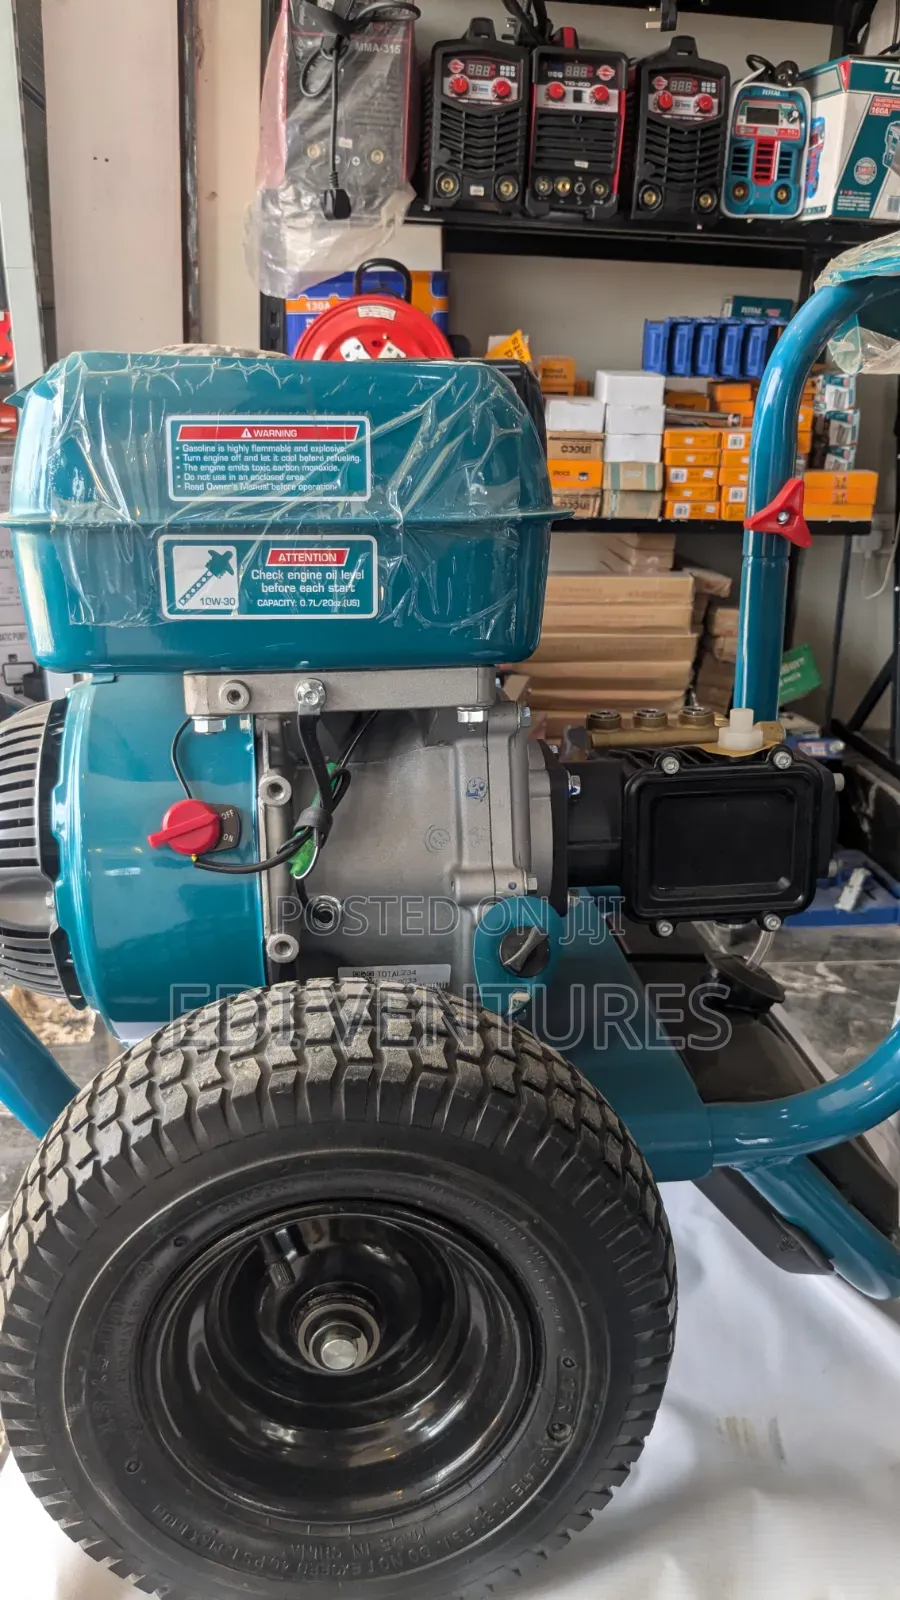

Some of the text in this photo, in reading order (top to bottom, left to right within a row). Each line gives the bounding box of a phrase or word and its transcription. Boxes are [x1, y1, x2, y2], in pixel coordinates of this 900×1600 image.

[355, 42, 401, 54] MMA-315
[871, 107, 889, 115] 160A
[306, 301, 331, 311] 130A
[253, 429, 298, 438] WARNING
[182, 444, 216, 452] Gasoline
[218, 444, 225, 452] is
[227, 444, 249, 454] highly
[251, 444, 291, 452] flammable
[294, 444, 308, 452] and
[203, 454, 229, 463] engine
[326, 454, 361, 463] refueling.
[183, 463, 340, 473] The engine emits toxic carbon monoxide.
[184, 473, 195, 481] Do
[197, 473, 211, 481] not
[213, 473, 226, 481] use
[229, 473, 236, 481] in
[239, 473, 248, 481] an
[251, 473, 284, 481] enclosed
[278, 553, 337, 562] ATTENTION
[251, 570, 365, 582] Check engine oil level
[261, 583, 356, 593] before each start
[199, 597, 236, 606] 10W-30
[257, 599, 298, 607] CAPACITY:
[221, 809, 235, 820] OFF
[223, 833, 234, 843] ON
